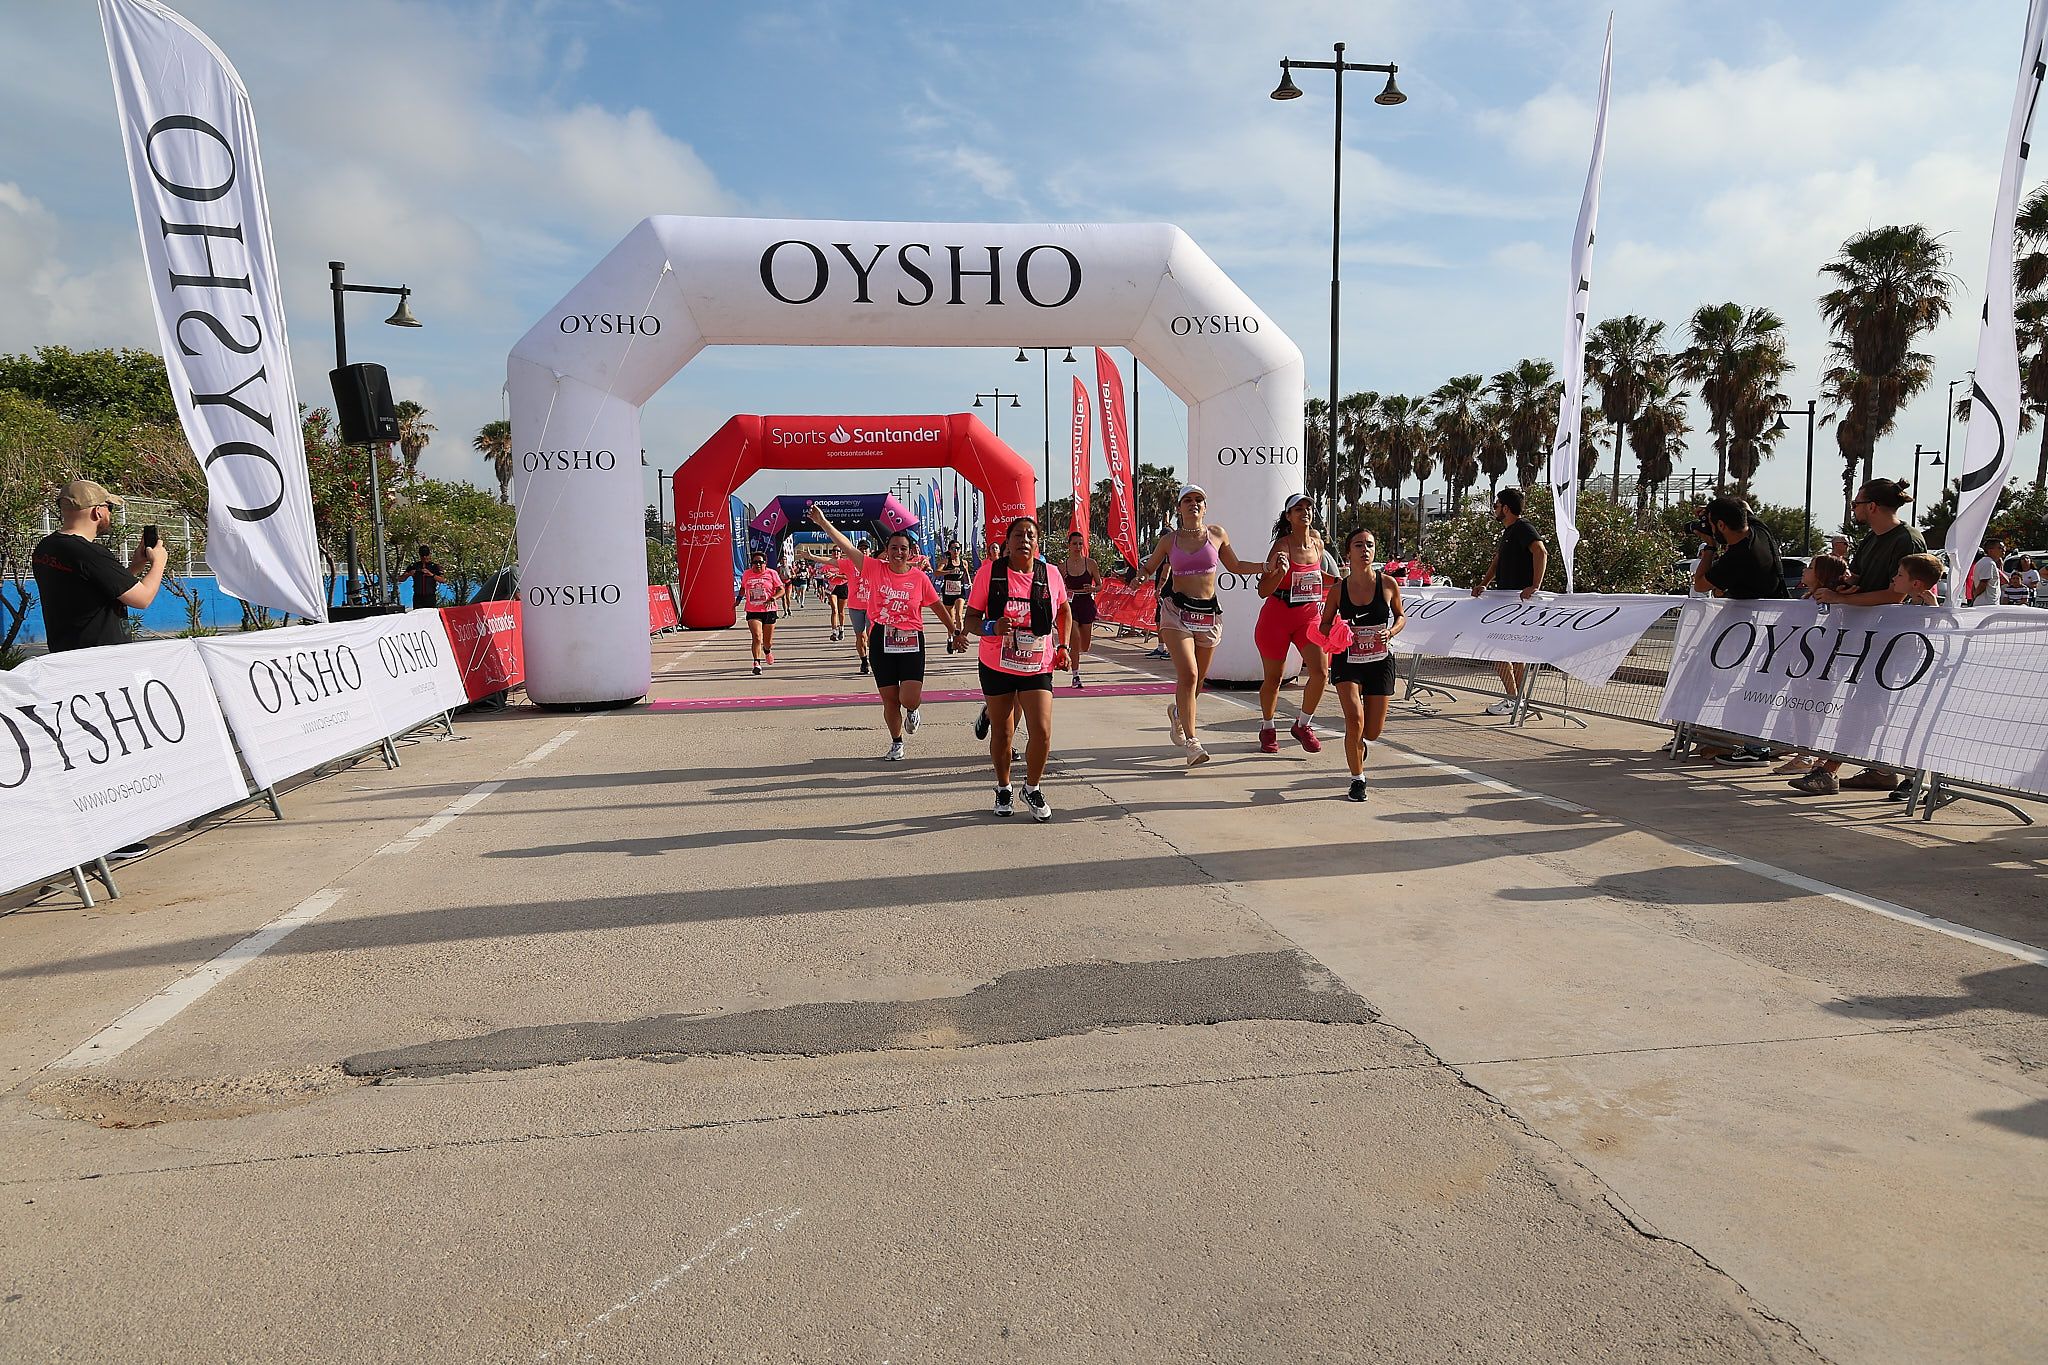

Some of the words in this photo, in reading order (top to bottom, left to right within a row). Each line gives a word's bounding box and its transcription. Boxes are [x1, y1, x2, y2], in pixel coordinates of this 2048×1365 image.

[760, 241, 1082, 308] OYSHO
[559, 313, 661, 336] OYSHO
[1170, 314, 1259, 336] OYSHO
[772, 428, 827, 448] Sports
[853, 427, 941, 444] Santander
[522, 450, 616, 473] OYSHO
[826, 449, 884, 458] sportssantander.es
[1217, 446, 1299, 466] OYSHO
[688, 510, 715, 519] Sports
[1002, 502, 1026, 511] Sports
[687, 522, 726, 532] Santander
[529, 584, 621, 607] OYSHO
[1006, 601, 1031, 612] CARR
[452, 619, 479, 647] Sports
[484, 611, 517, 634] Santander
[377, 630, 438, 679] OYSHO
[1015, 650, 1033, 658] 016
[1359, 642, 1375, 650] 016
[1709, 621, 1936, 692] OYSHO
[249, 644, 362, 714] OYSHO
[1743, 690, 1844, 715] WWW.OYSHO.COM
[72, 772, 166, 813] WWW.OYSHO.COM
